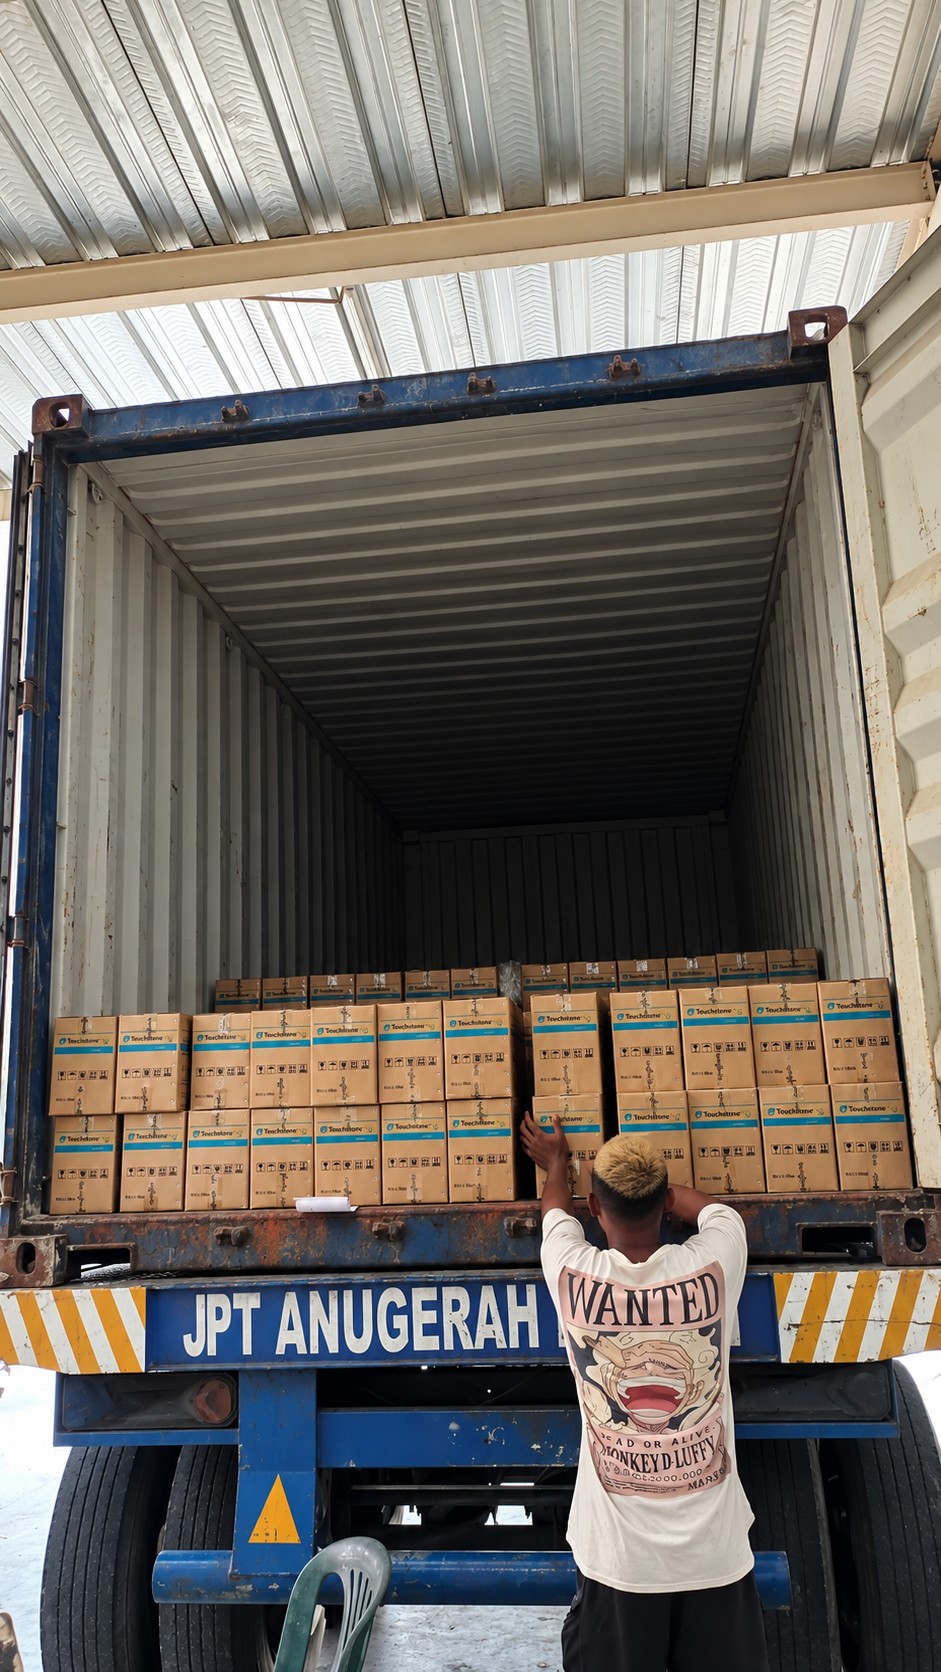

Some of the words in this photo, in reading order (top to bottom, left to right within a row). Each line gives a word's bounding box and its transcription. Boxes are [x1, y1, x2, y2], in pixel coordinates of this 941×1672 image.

[183, 1292, 261, 1358] JPT
[275, 1284, 540, 1354] ANUGERAH
[567, 1272, 721, 1326] WANTED
[643, 1440, 662, 1449] OR
[671, 1426, 711, 1446] ALIVE
